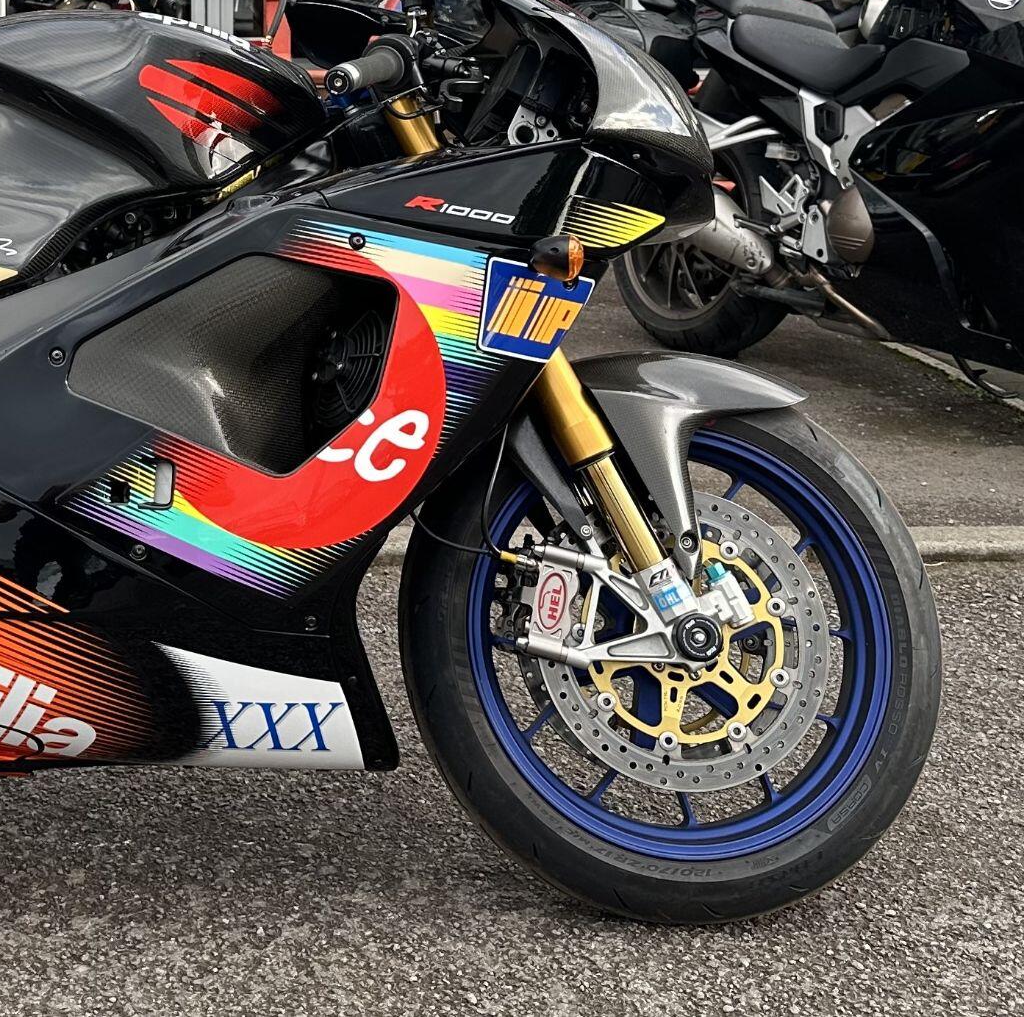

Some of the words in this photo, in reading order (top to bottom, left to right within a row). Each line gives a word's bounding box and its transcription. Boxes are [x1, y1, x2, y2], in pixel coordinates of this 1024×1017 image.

[405, 195, 516, 225] R1000
[547, 585, 563, 621] HEL
[197, 700, 345, 752] XXX
[829, 781, 870, 825] CORSA
